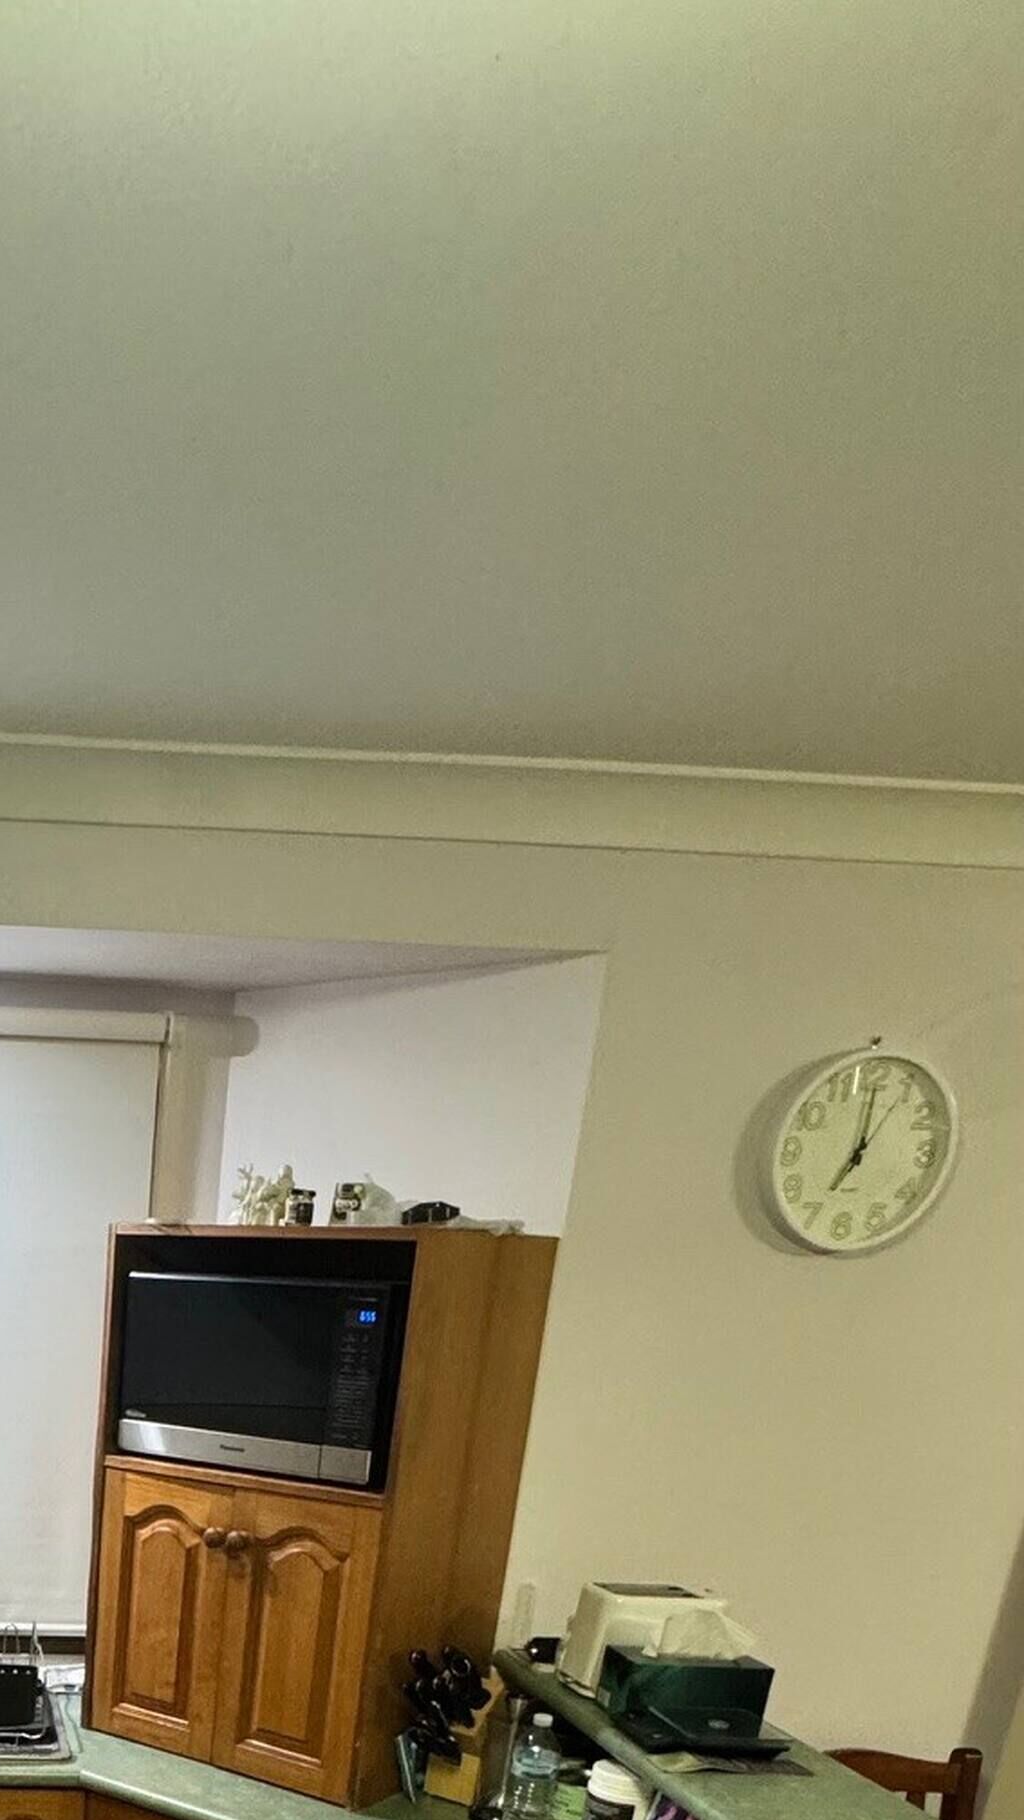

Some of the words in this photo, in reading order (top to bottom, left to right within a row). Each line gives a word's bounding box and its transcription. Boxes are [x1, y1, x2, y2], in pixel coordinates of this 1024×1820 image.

[827, 1071, 854, 1102] 11
[860, 1061, 892, 1092] 12
[899, 1071, 916, 1103] 1
[795, 1100, 826, 1131] 10
[910, 1101, 936, 1131] 2
[780, 1135, 803, 1167] 9
[913, 1139, 937, 1169] 3
[783, 1173, 803, 1203] 8
[894, 1176, 919, 1205] 4
[802, 1202, 824, 1230] 7
[830, 1211, 853, 1241] 6
[864, 1202, 887, 1232] 5
